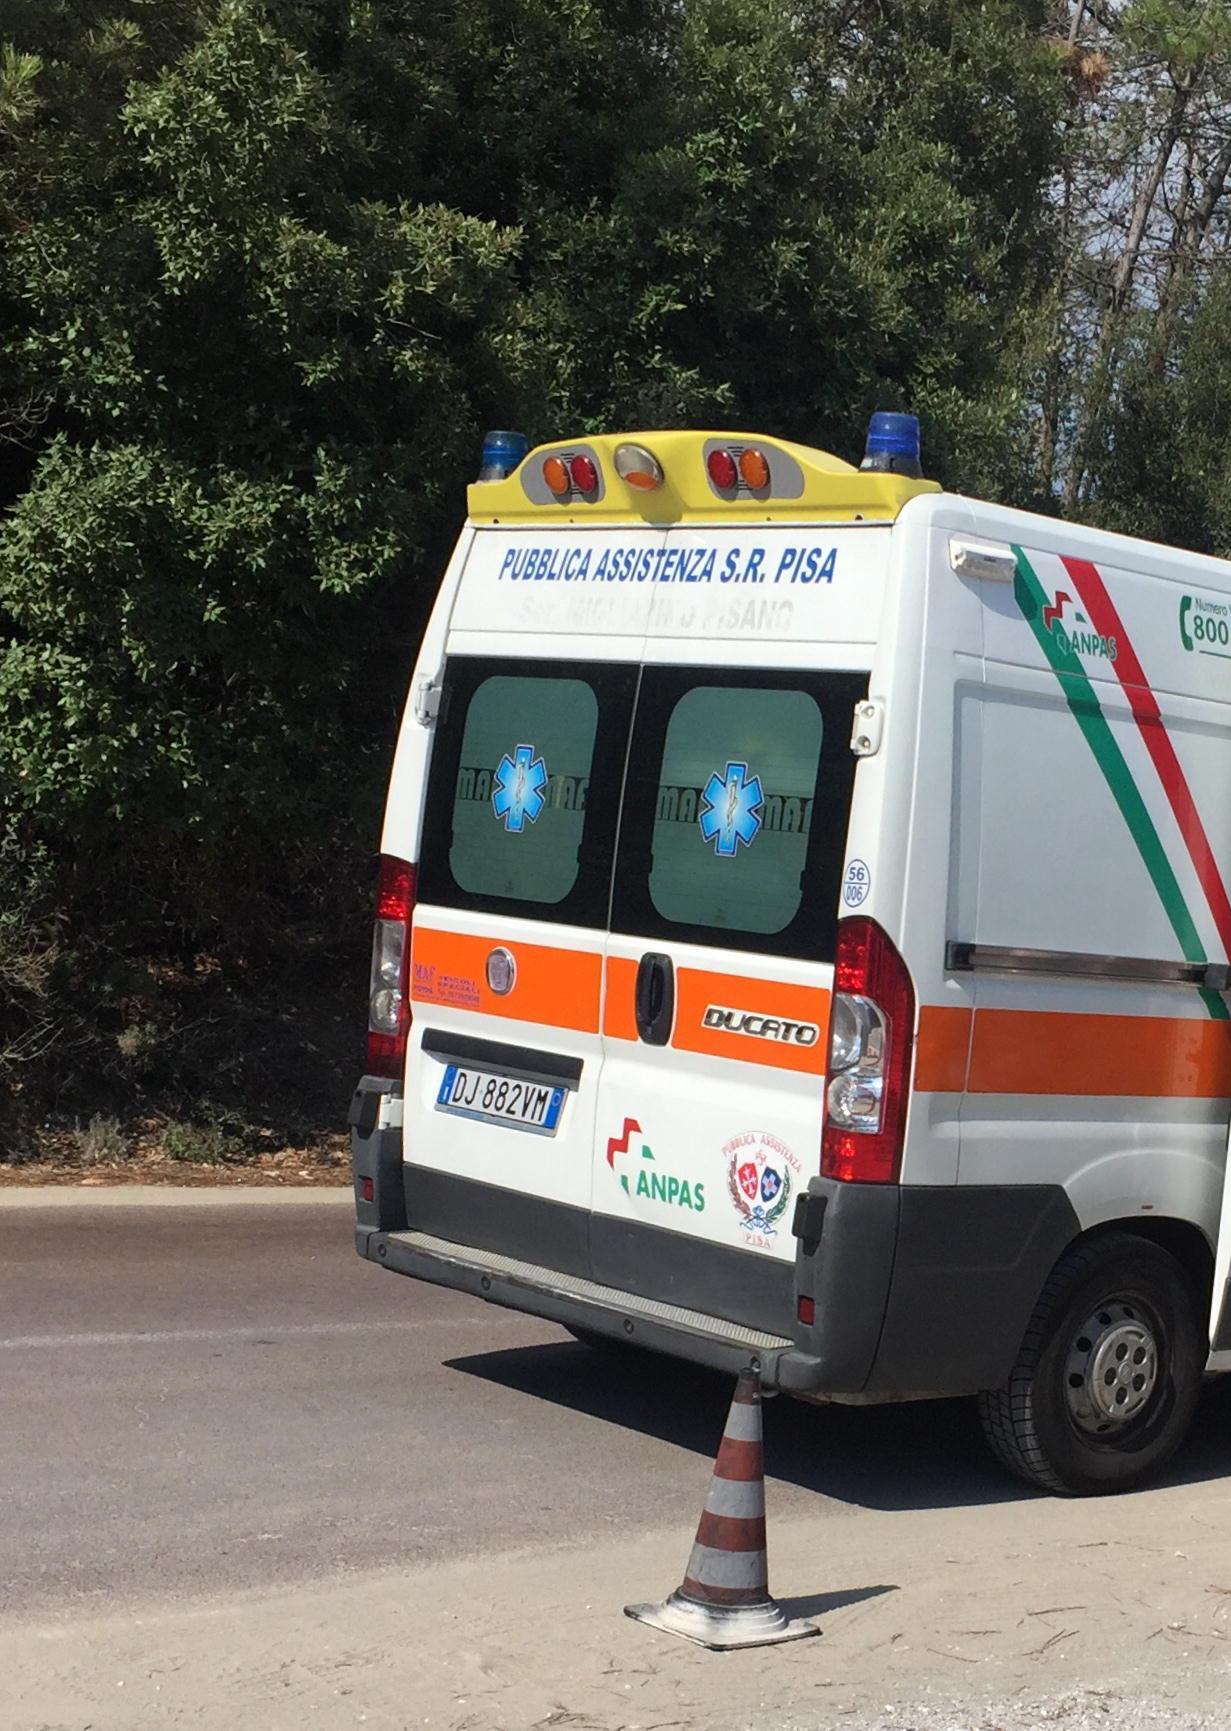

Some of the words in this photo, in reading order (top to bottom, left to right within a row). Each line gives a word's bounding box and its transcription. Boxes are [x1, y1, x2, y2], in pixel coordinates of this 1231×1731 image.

[499, 548, 593, 582] PUBBLICA
[592, 548, 718, 583] ASSISTENZA
[719, 548, 767, 584] S.R.
[774, 547, 838, 585] PISA
[1195, 597, 1227, 617] Numero
[1070, 630, 1118, 662] ANPAS
[1193, 614, 1229, 646] 800
[848, 866, 865, 882] 56
[703, 1007, 818, 1046] DUCATO
[482, 1078, 550, 1122] 882VM
[760, 1134, 803, 1174] ASSISTENZA
[636, 1168, 706, 1213] ANPAS
[745, 1232, 772, 1249] PISA
